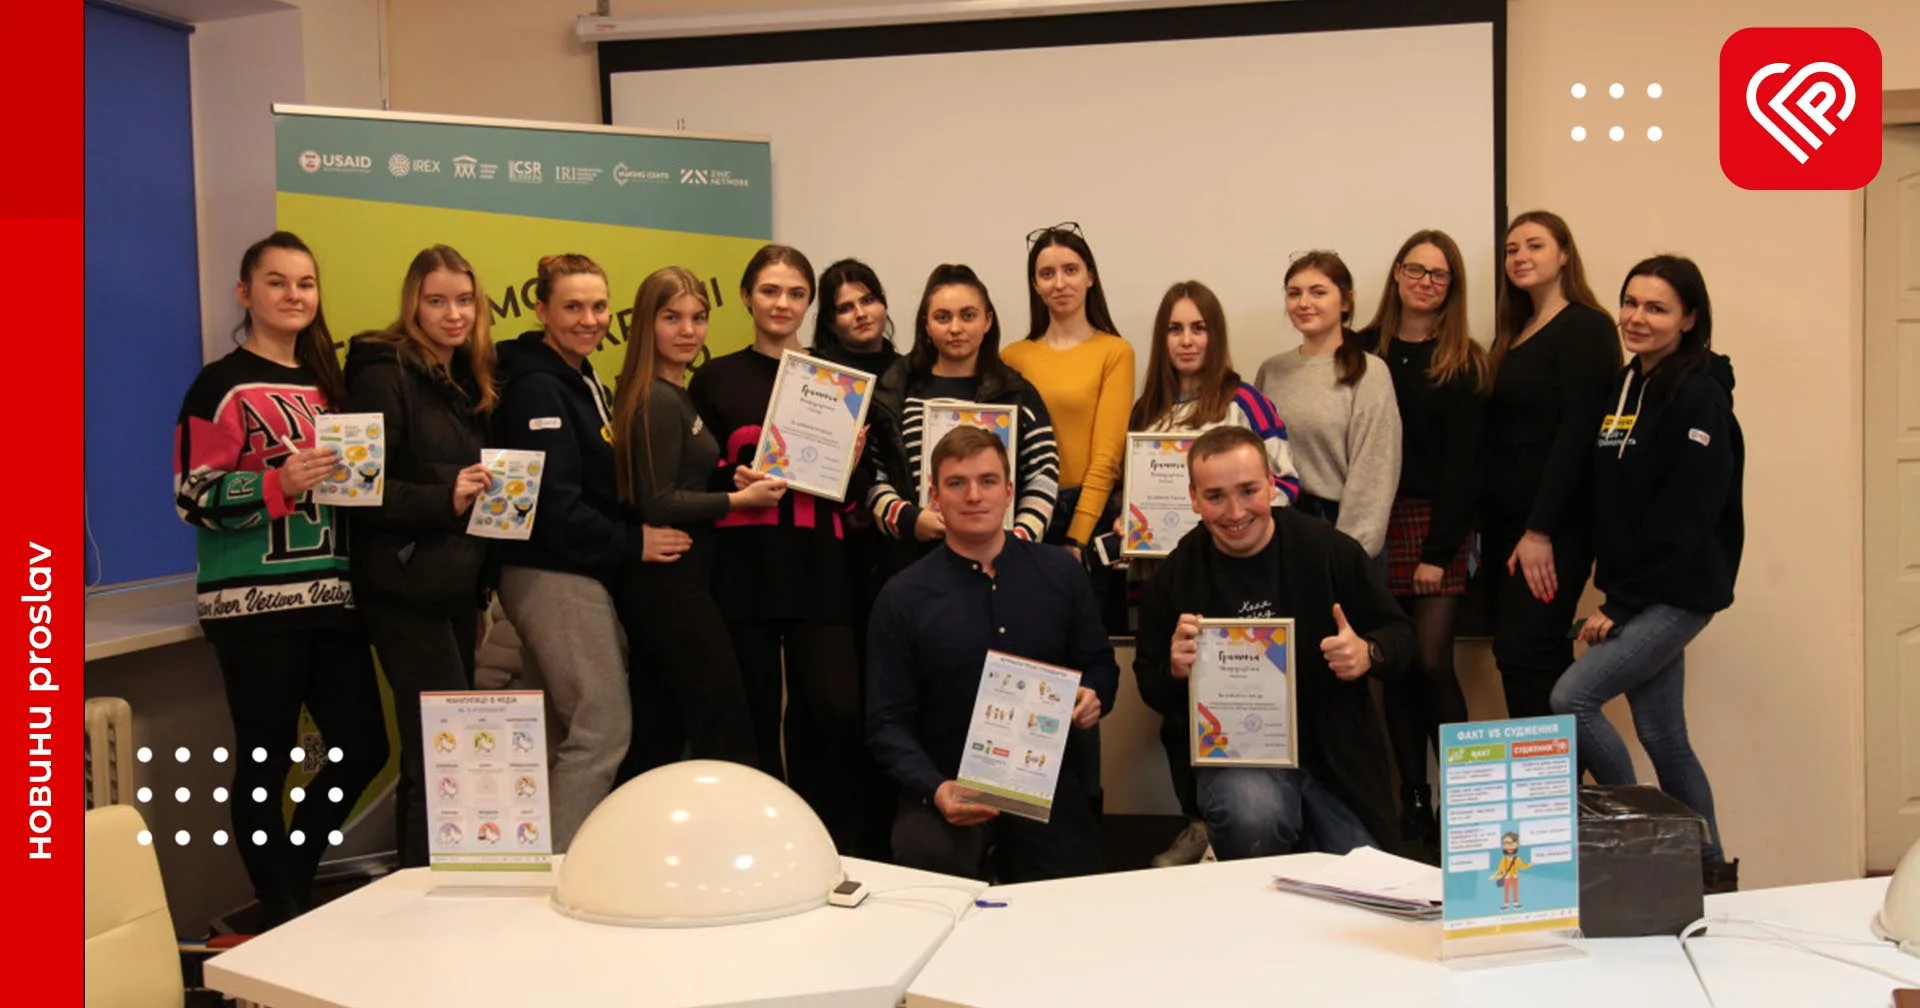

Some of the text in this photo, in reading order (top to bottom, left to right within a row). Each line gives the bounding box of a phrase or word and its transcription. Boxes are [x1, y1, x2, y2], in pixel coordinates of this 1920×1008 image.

[322, 154, 373, 169] USAID
[412, 159, 441, 174] IREX
[514, 160, 542, 175] CSR
[555, 165, 576, 181] IRI
[1456, 723, 1559, 741] ФАКТ VS СУДЖЕННЯ
